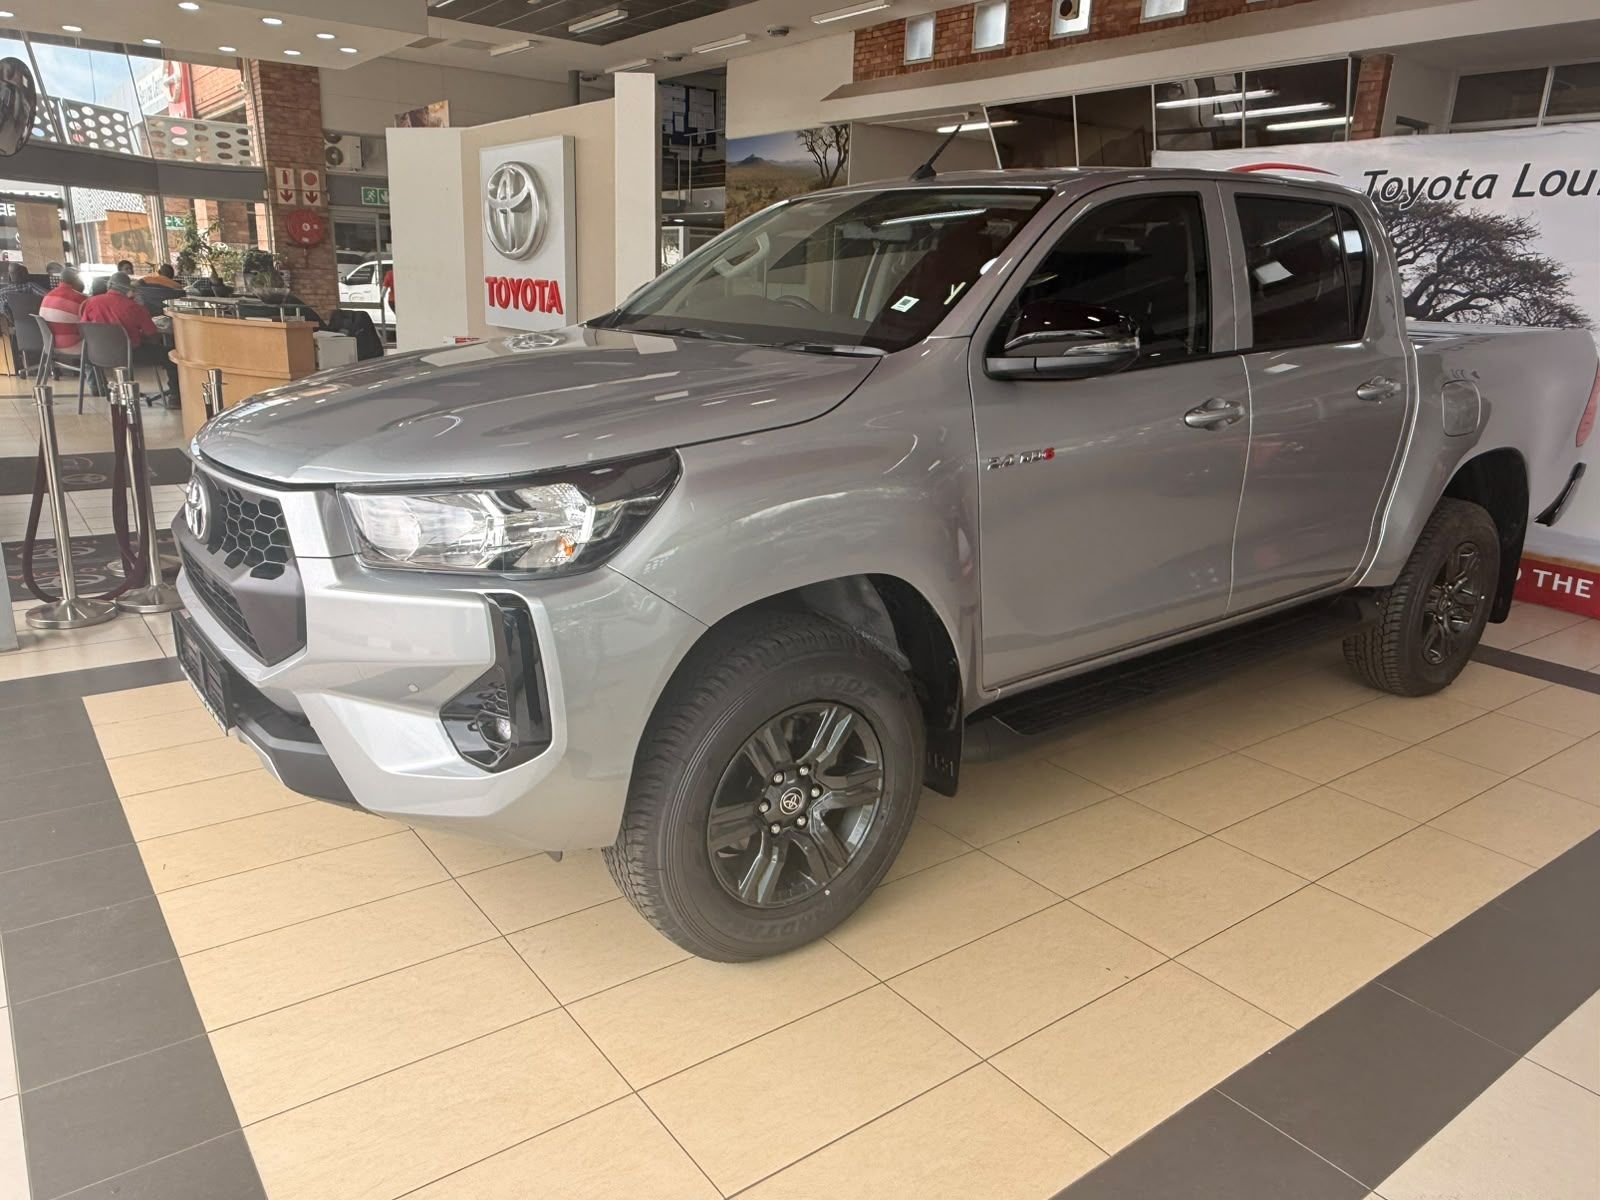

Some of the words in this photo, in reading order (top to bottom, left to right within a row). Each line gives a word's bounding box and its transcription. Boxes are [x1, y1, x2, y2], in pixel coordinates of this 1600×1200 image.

[1363, 168, 1499, 210] Toyota
[1512, 163, 1600, 199] Lou
[485, 276, 564, 315] TOYOTA
[1532, 568, 1594, 599] THE
